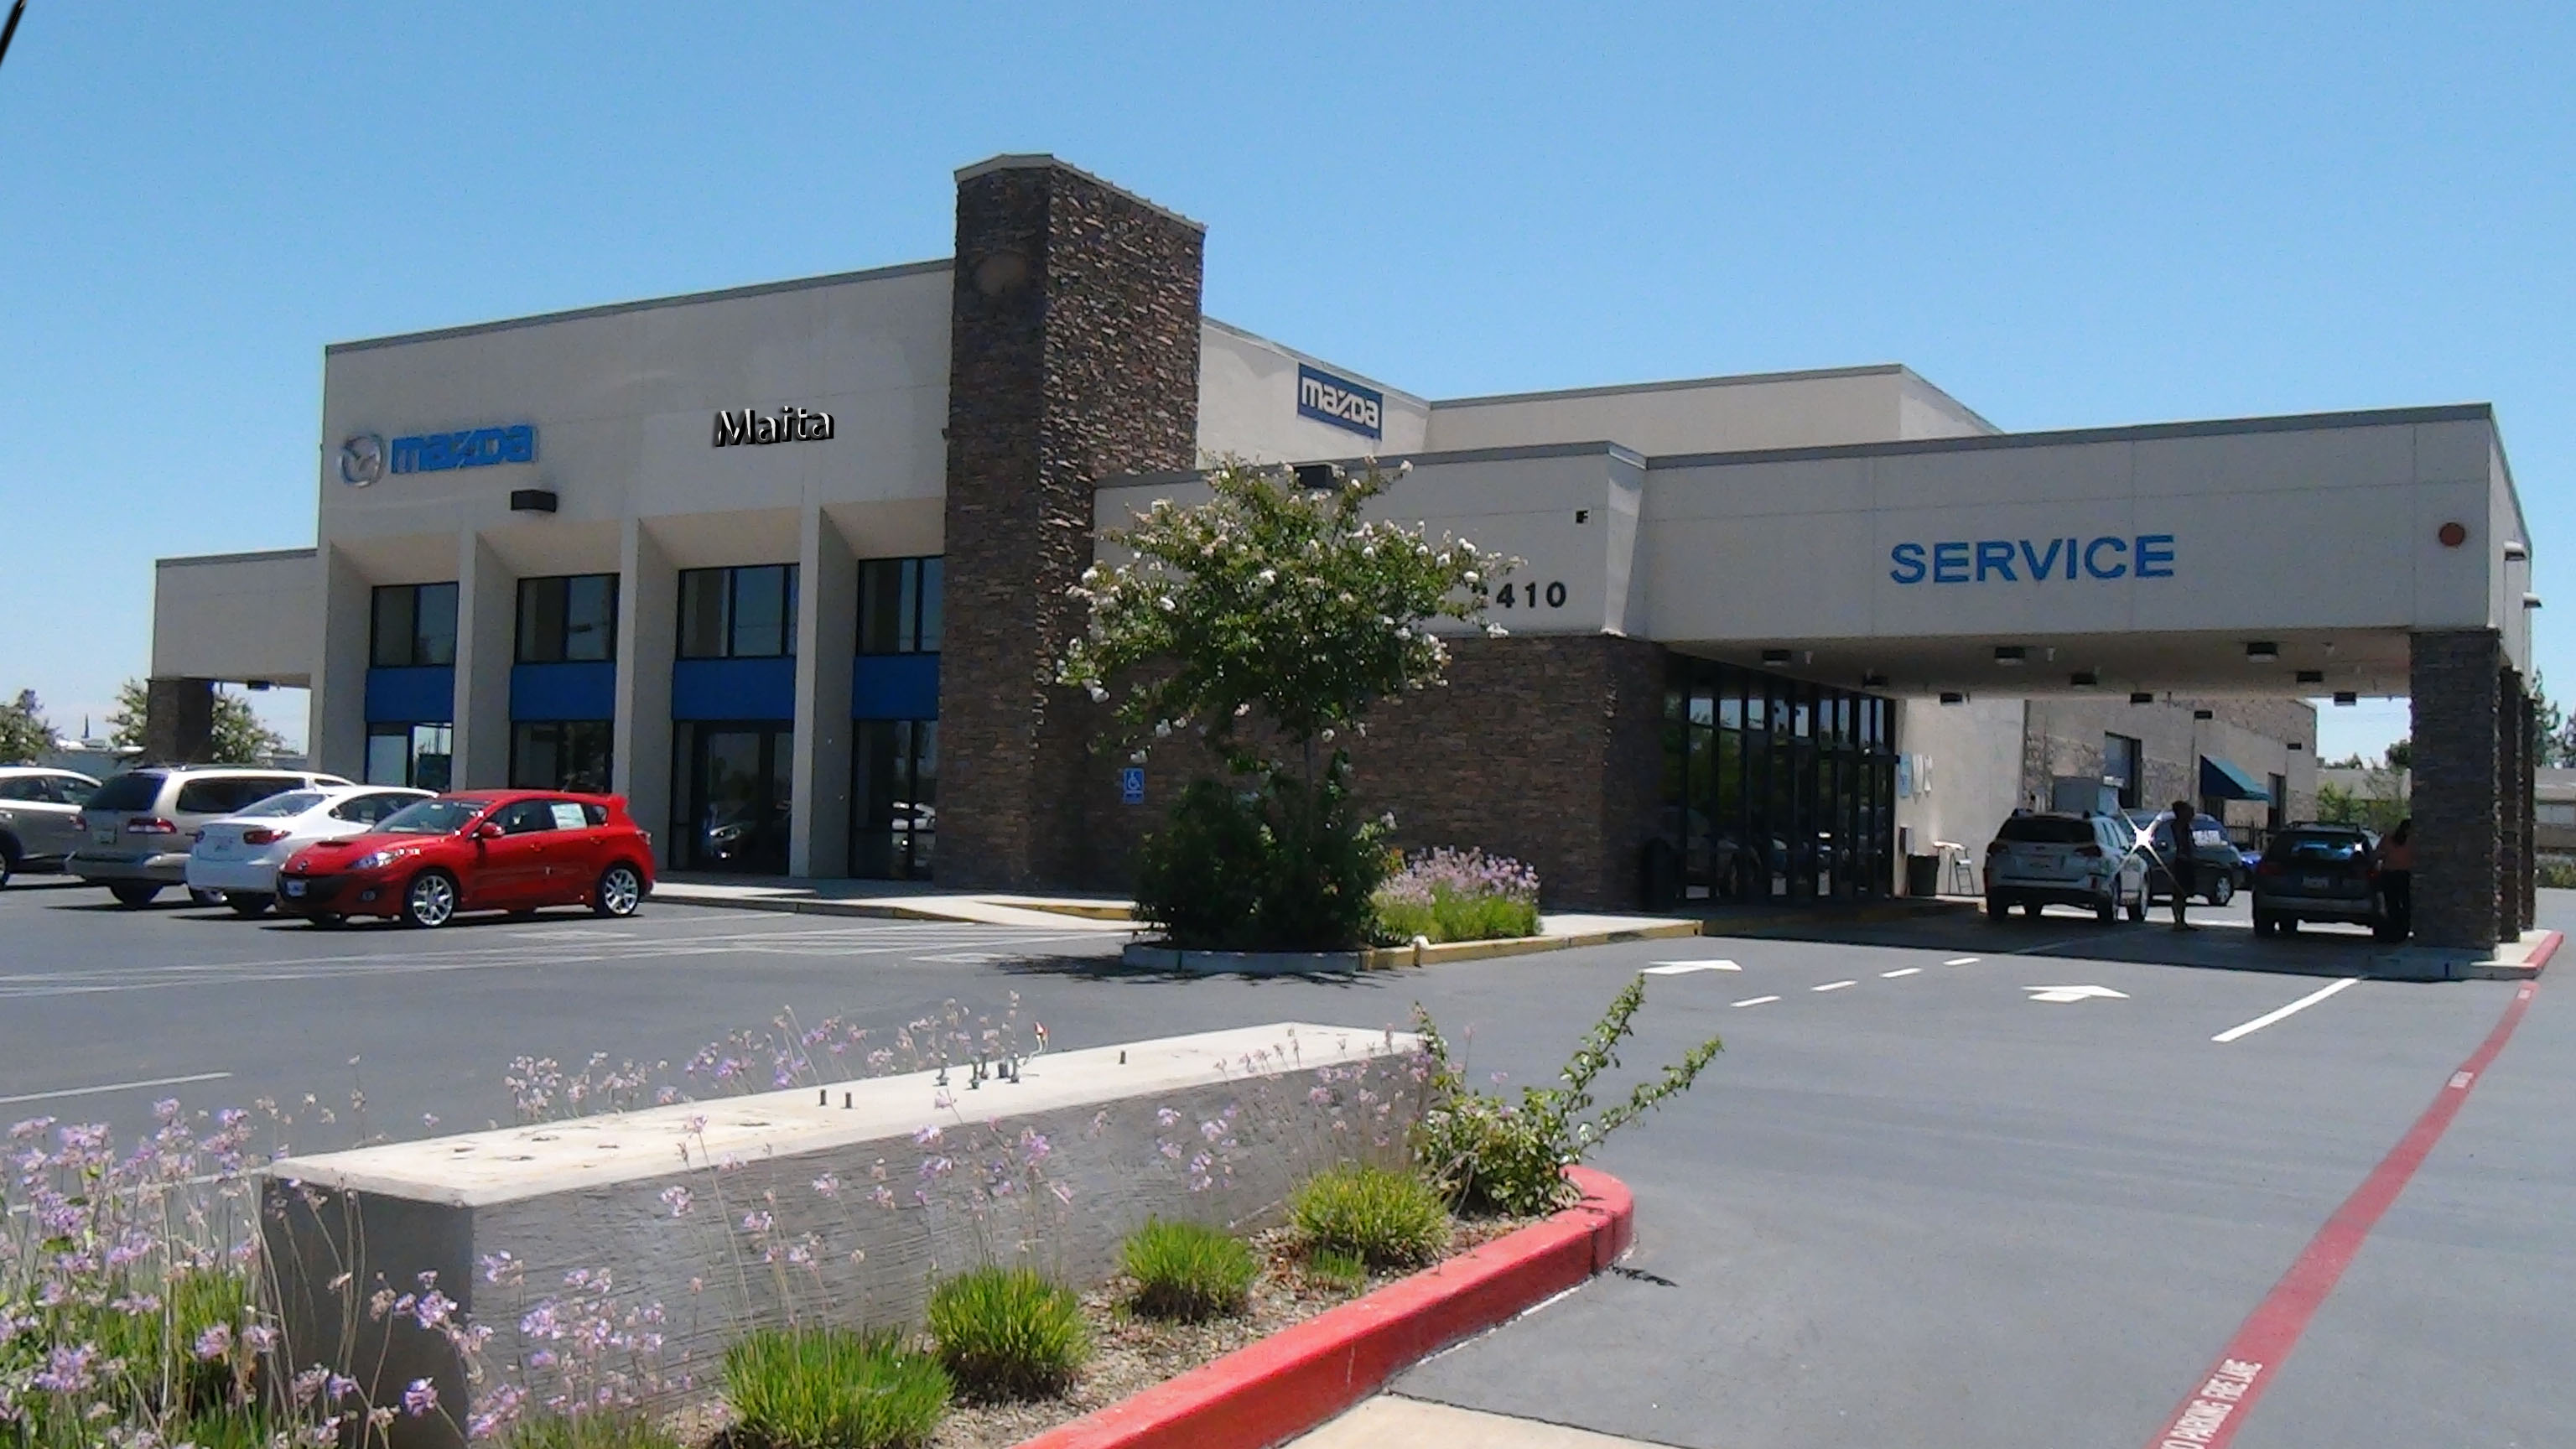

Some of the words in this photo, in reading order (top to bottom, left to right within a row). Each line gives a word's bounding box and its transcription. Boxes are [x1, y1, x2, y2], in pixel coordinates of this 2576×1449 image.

[715, 405, 834, 447] Maita
[1301, 376, 1379, 429] mazda
[391, 425, 538, 475] mazda
[1890, 534, 2174, 584] SERVICE
